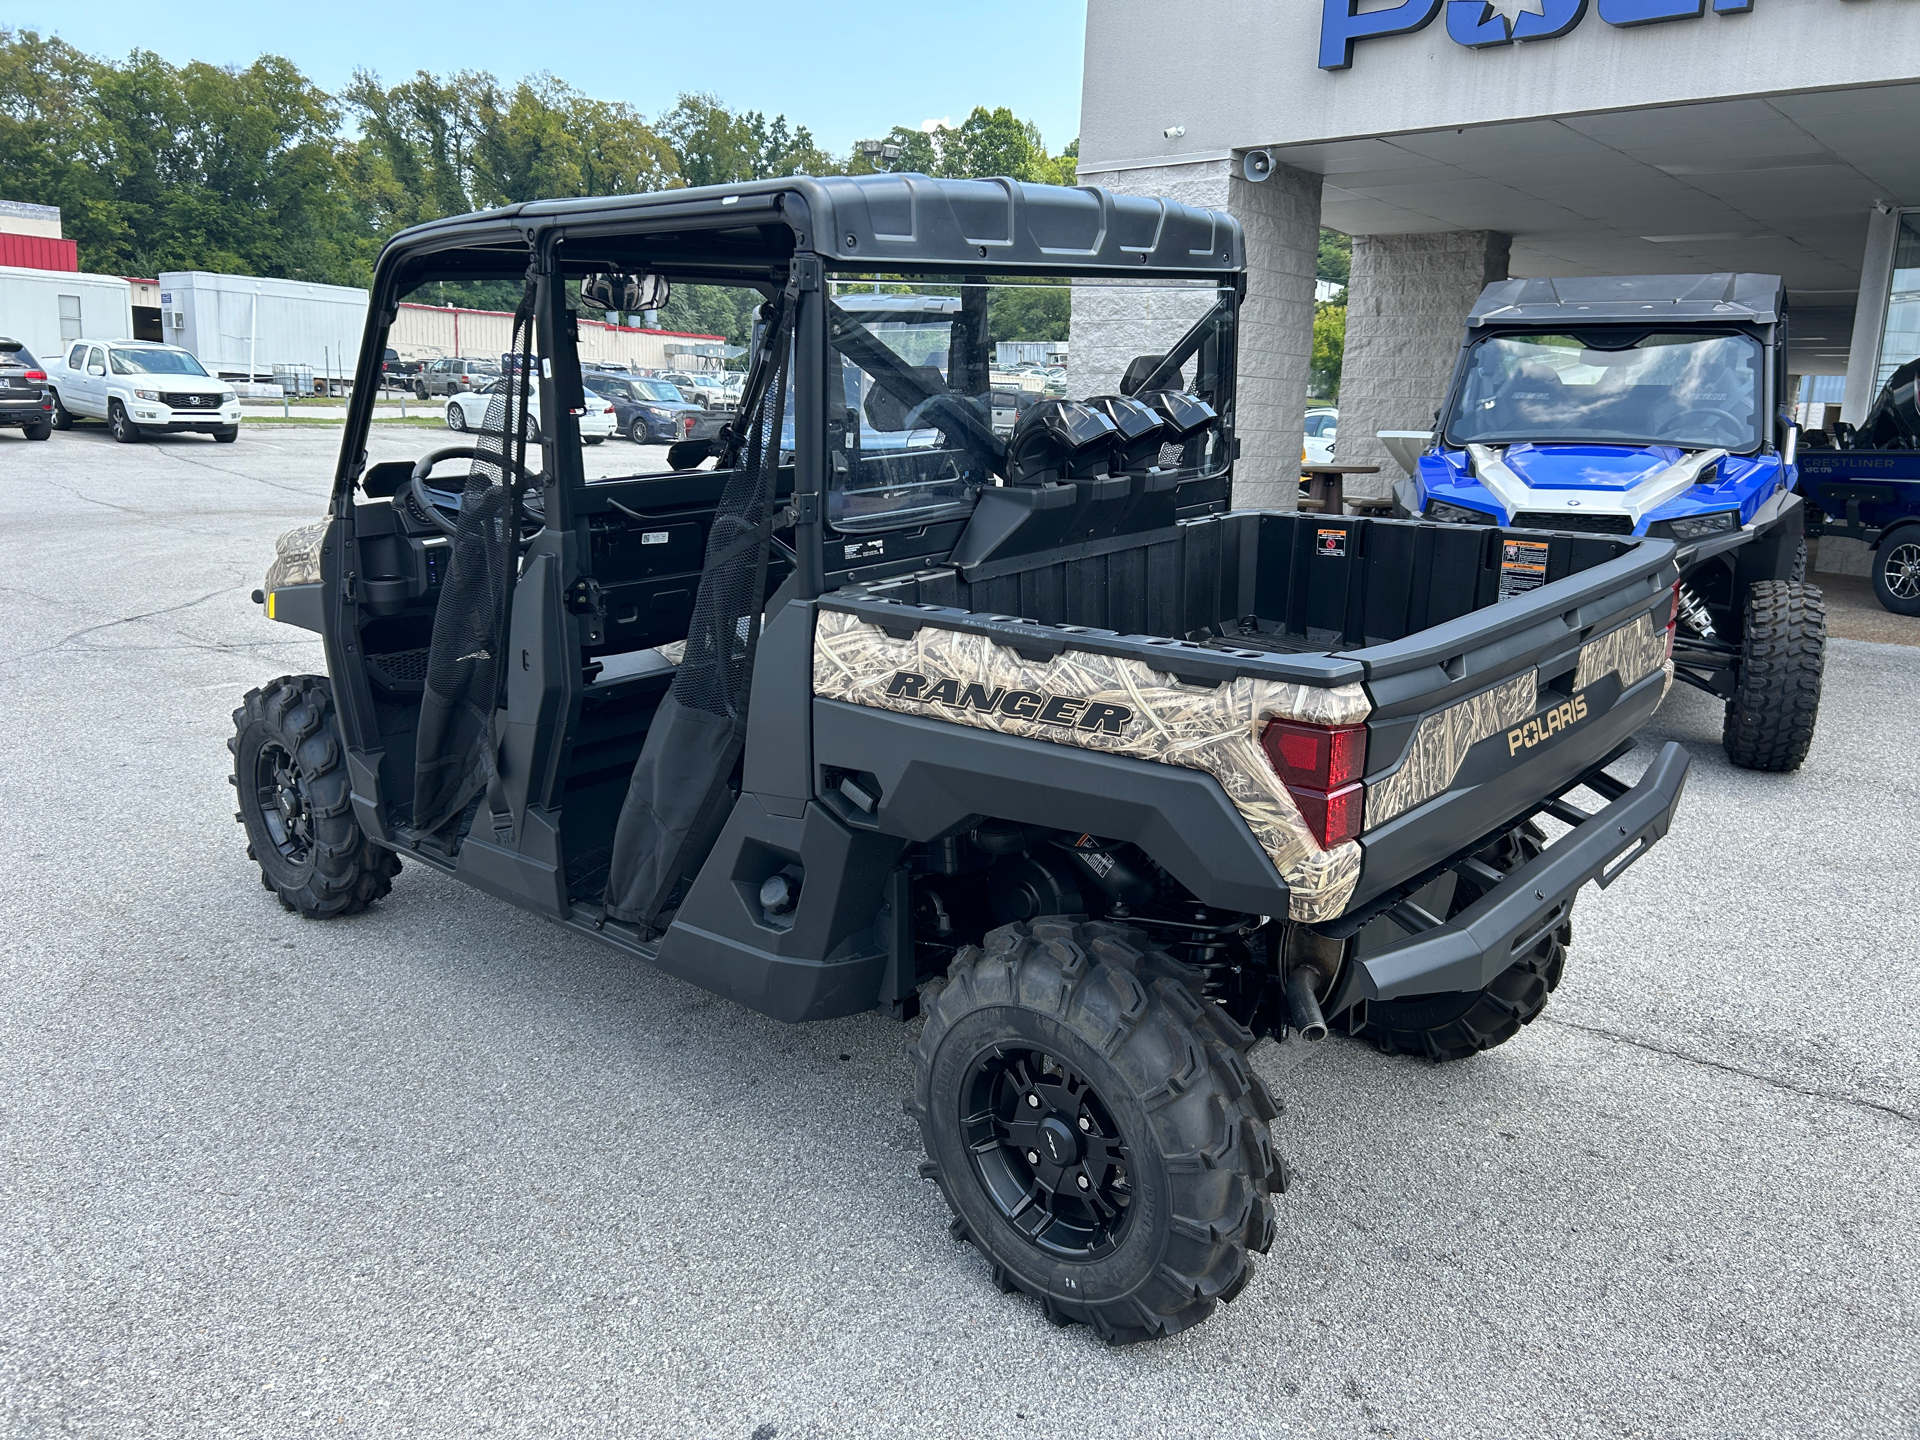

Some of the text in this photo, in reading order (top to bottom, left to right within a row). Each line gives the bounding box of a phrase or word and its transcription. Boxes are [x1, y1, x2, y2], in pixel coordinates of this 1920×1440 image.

[1802, 458, 1895, 468] CRESTLINER
[885, 670, 1133, 737] RANGER
[1507, 693, 1588, 757] POLARIS
